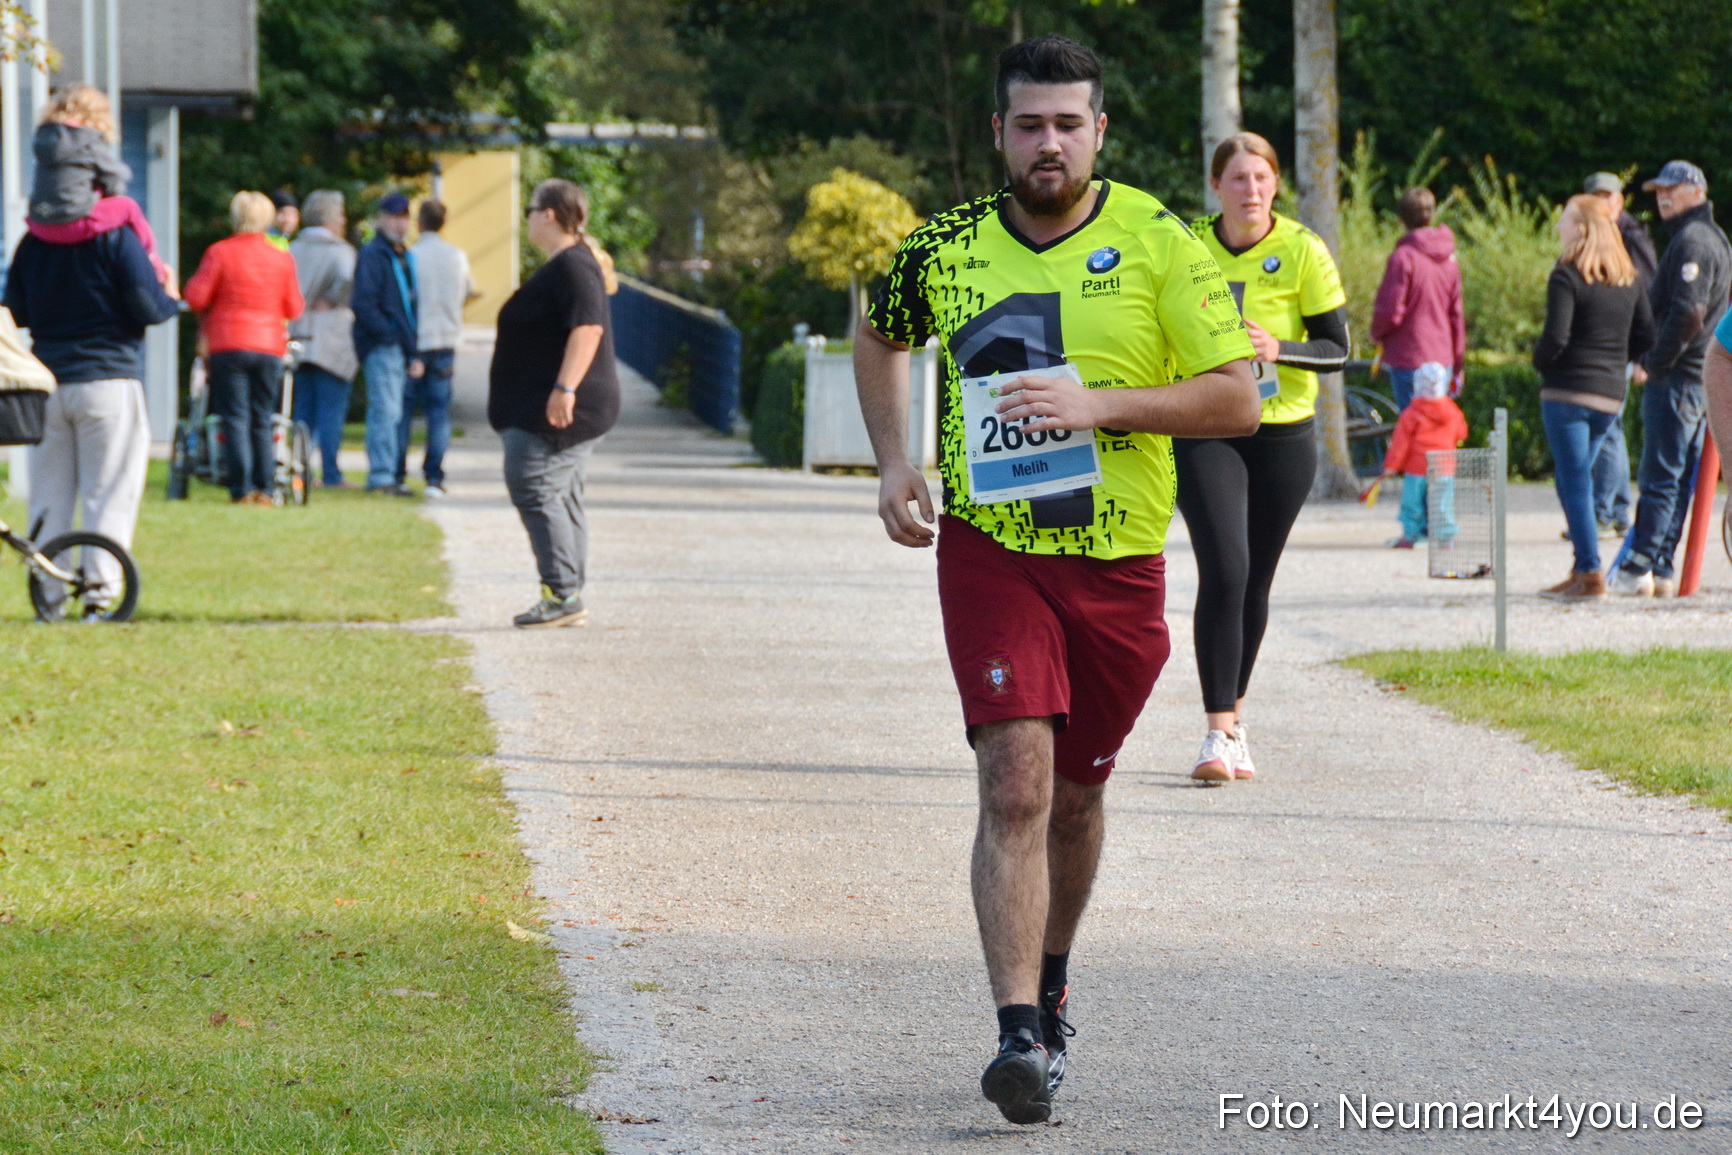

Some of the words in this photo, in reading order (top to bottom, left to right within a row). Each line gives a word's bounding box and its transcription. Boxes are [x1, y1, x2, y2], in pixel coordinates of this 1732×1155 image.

[1081, 276, 1120, 292] Partl
[1081, 289, 1120, 299] Neumarkt
[1209, 328, 1220, 337] 100
[1088, 379, 1112, 389] BMW
[1011, 460, 1049, 477] Melih
